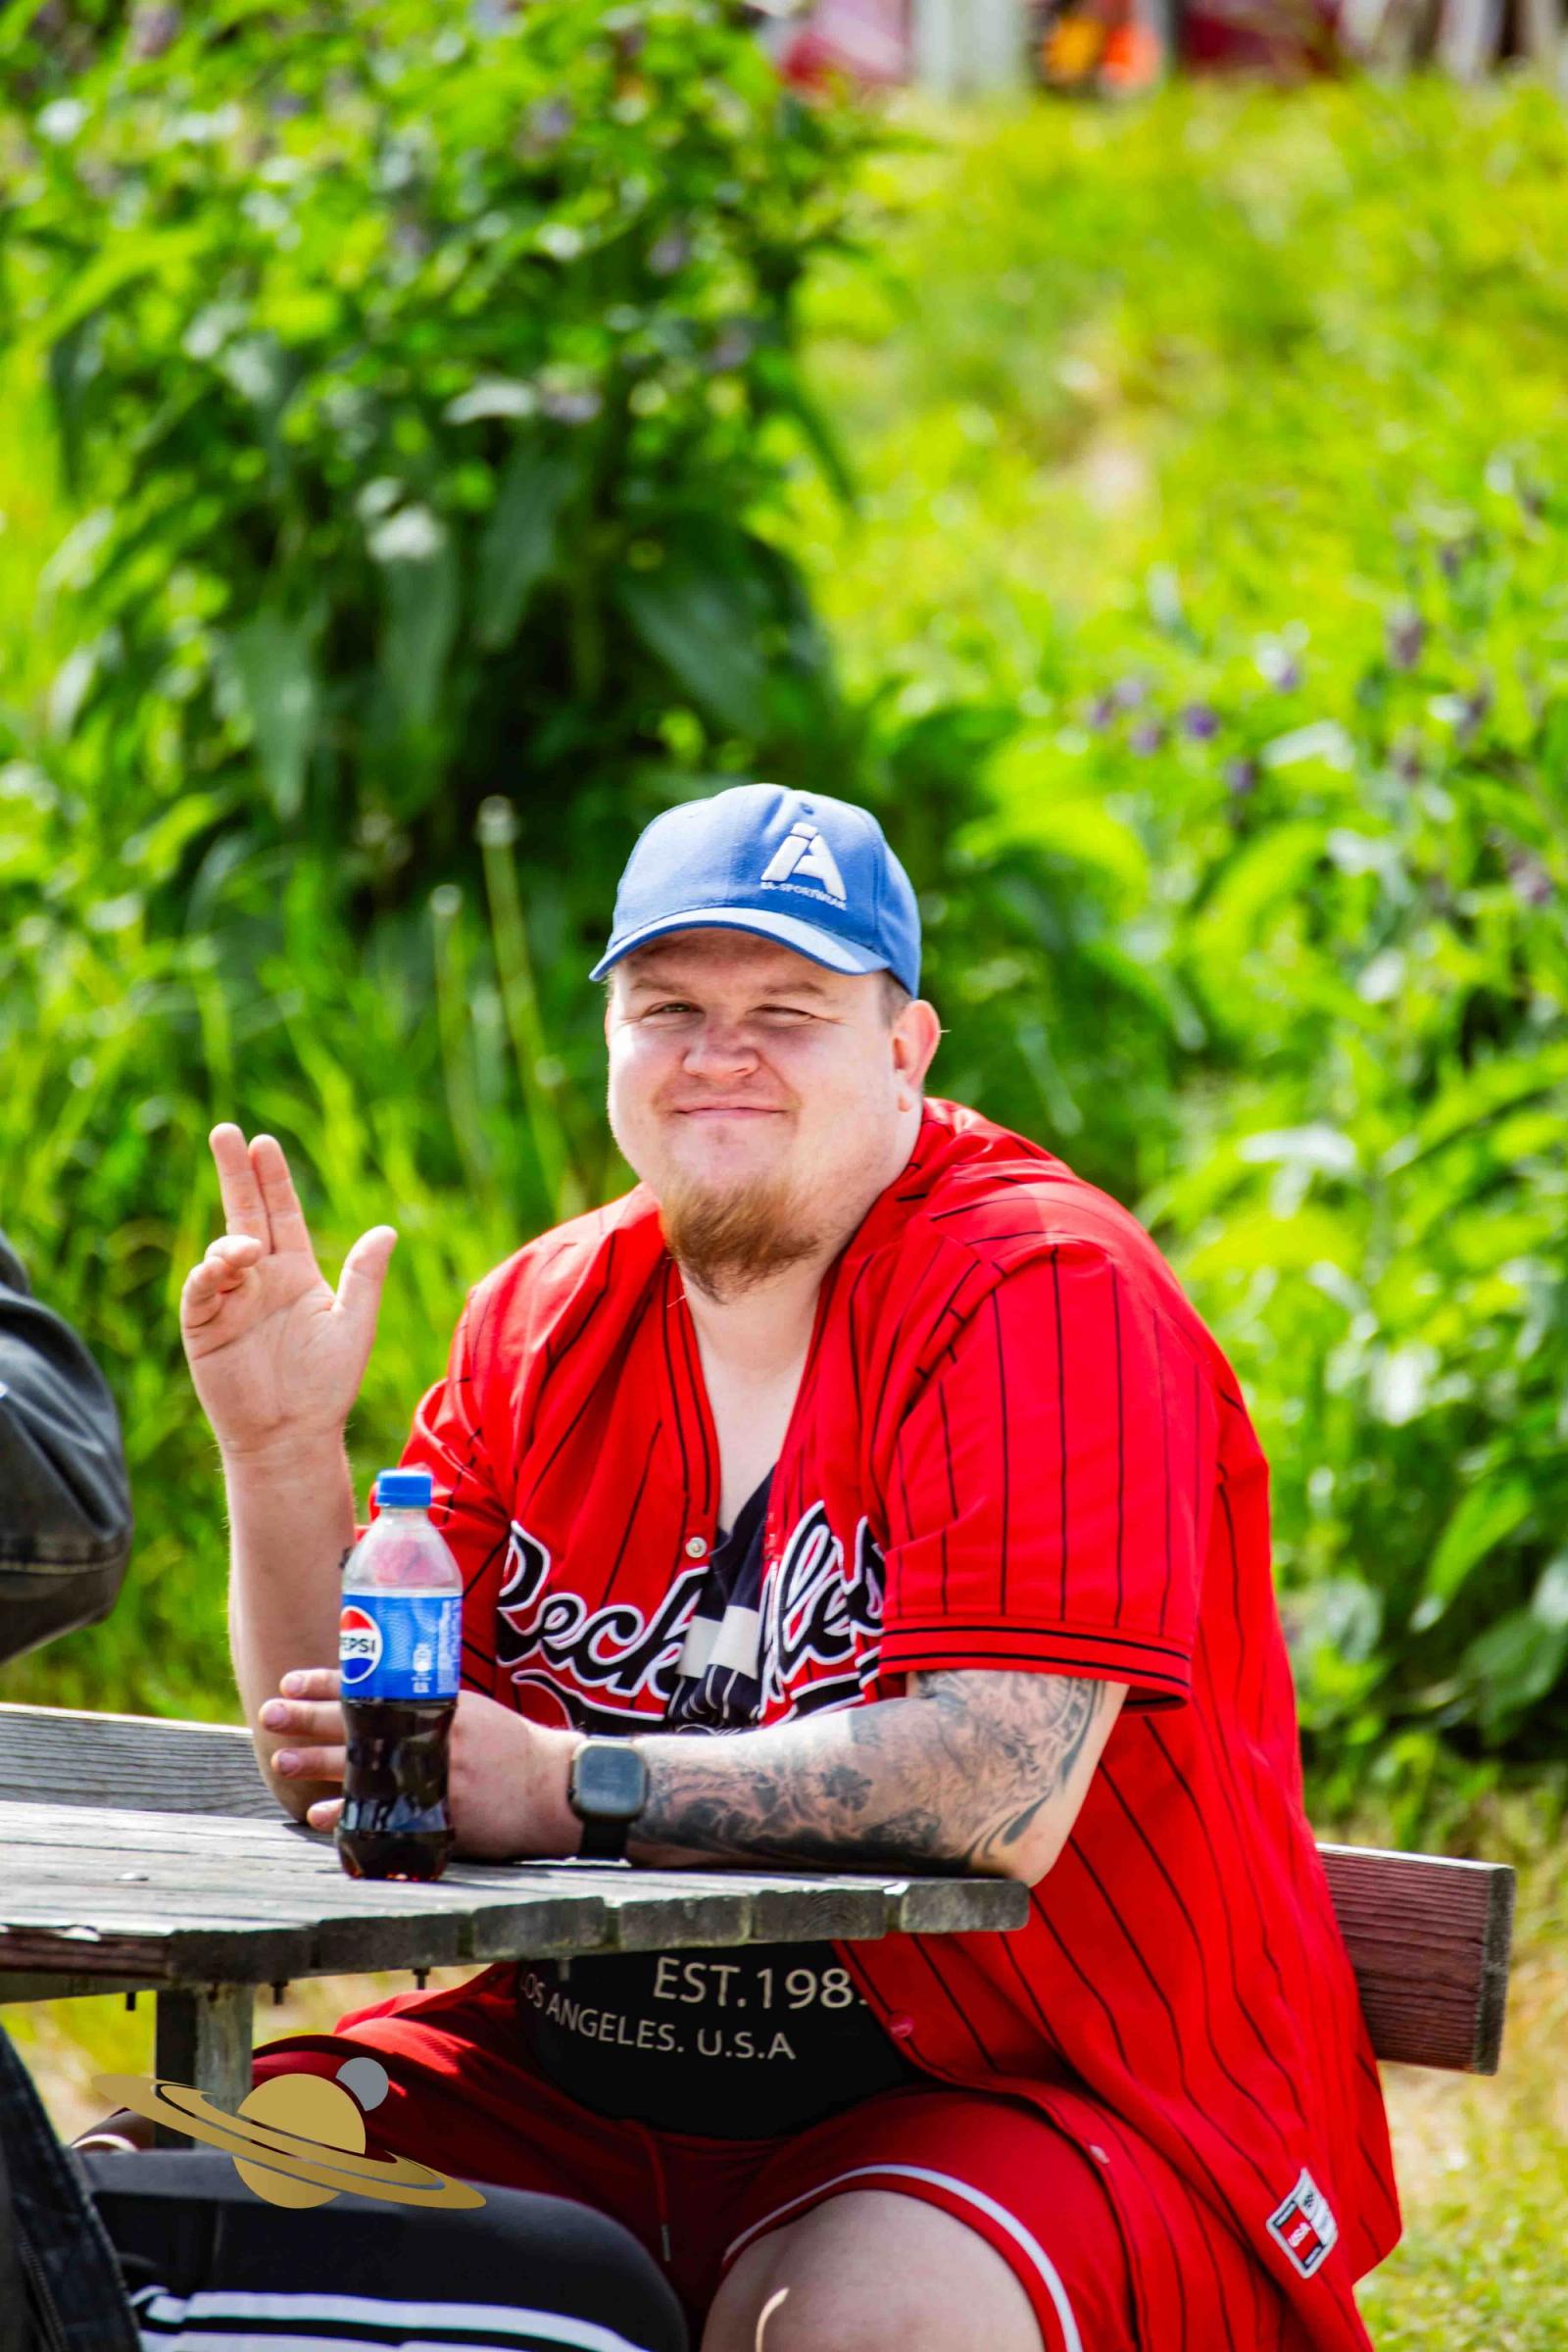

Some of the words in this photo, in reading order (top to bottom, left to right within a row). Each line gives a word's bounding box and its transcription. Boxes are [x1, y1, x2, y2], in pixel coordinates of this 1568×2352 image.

[653, 1957, 868, 2009] EST.198
[546, 1992, 685, 2053] ANGELES.
[697, 2028, 796, 2060] U.S.A
